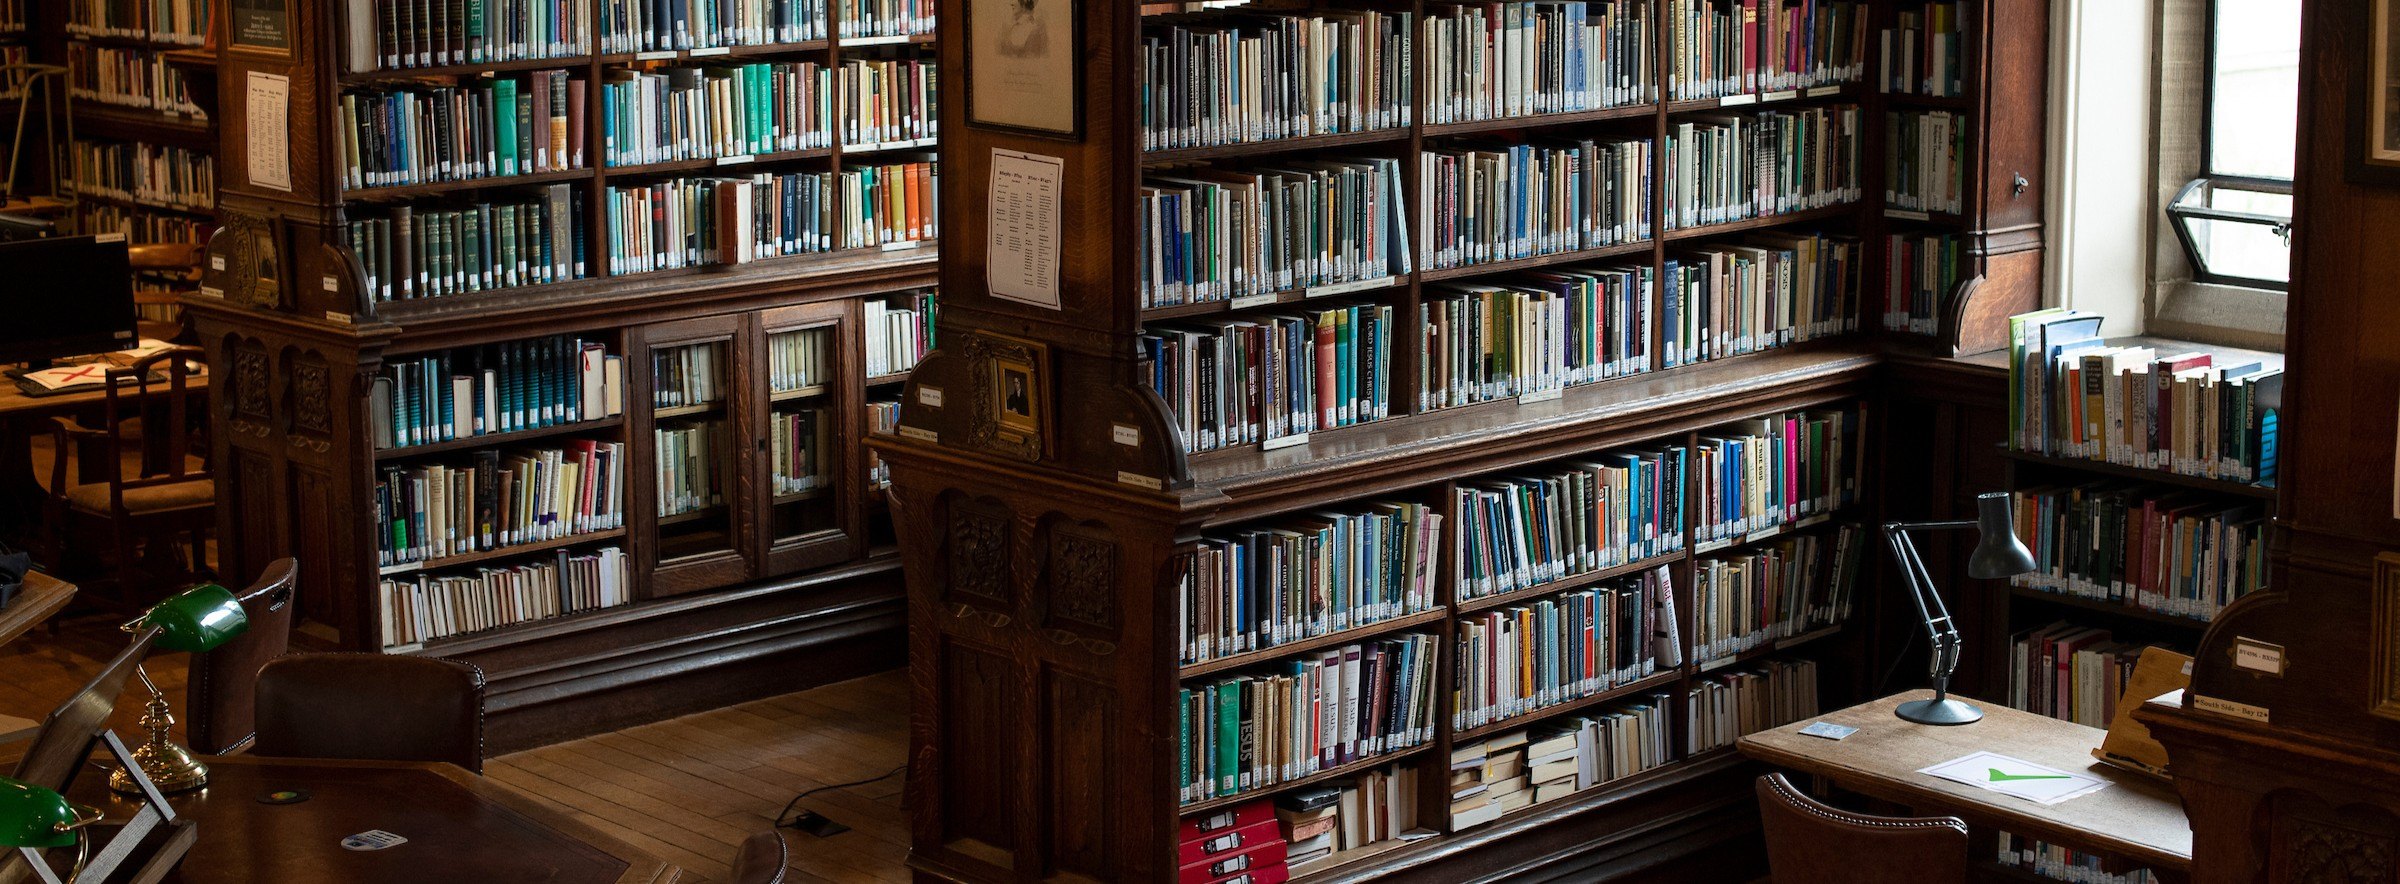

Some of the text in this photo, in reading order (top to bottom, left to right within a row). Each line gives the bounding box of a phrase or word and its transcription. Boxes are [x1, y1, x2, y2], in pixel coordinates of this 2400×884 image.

[1662, 580, 1671, 601] RACE
[1373, 655, 1382, 706] CHRISTOLOGY
[2200, 698, 2219, 710] South
[2221, 702, 2235, 712] Side
[2242, 708, 2255, 717] Bay
[1240, 721, 1252, 762] JESUS
